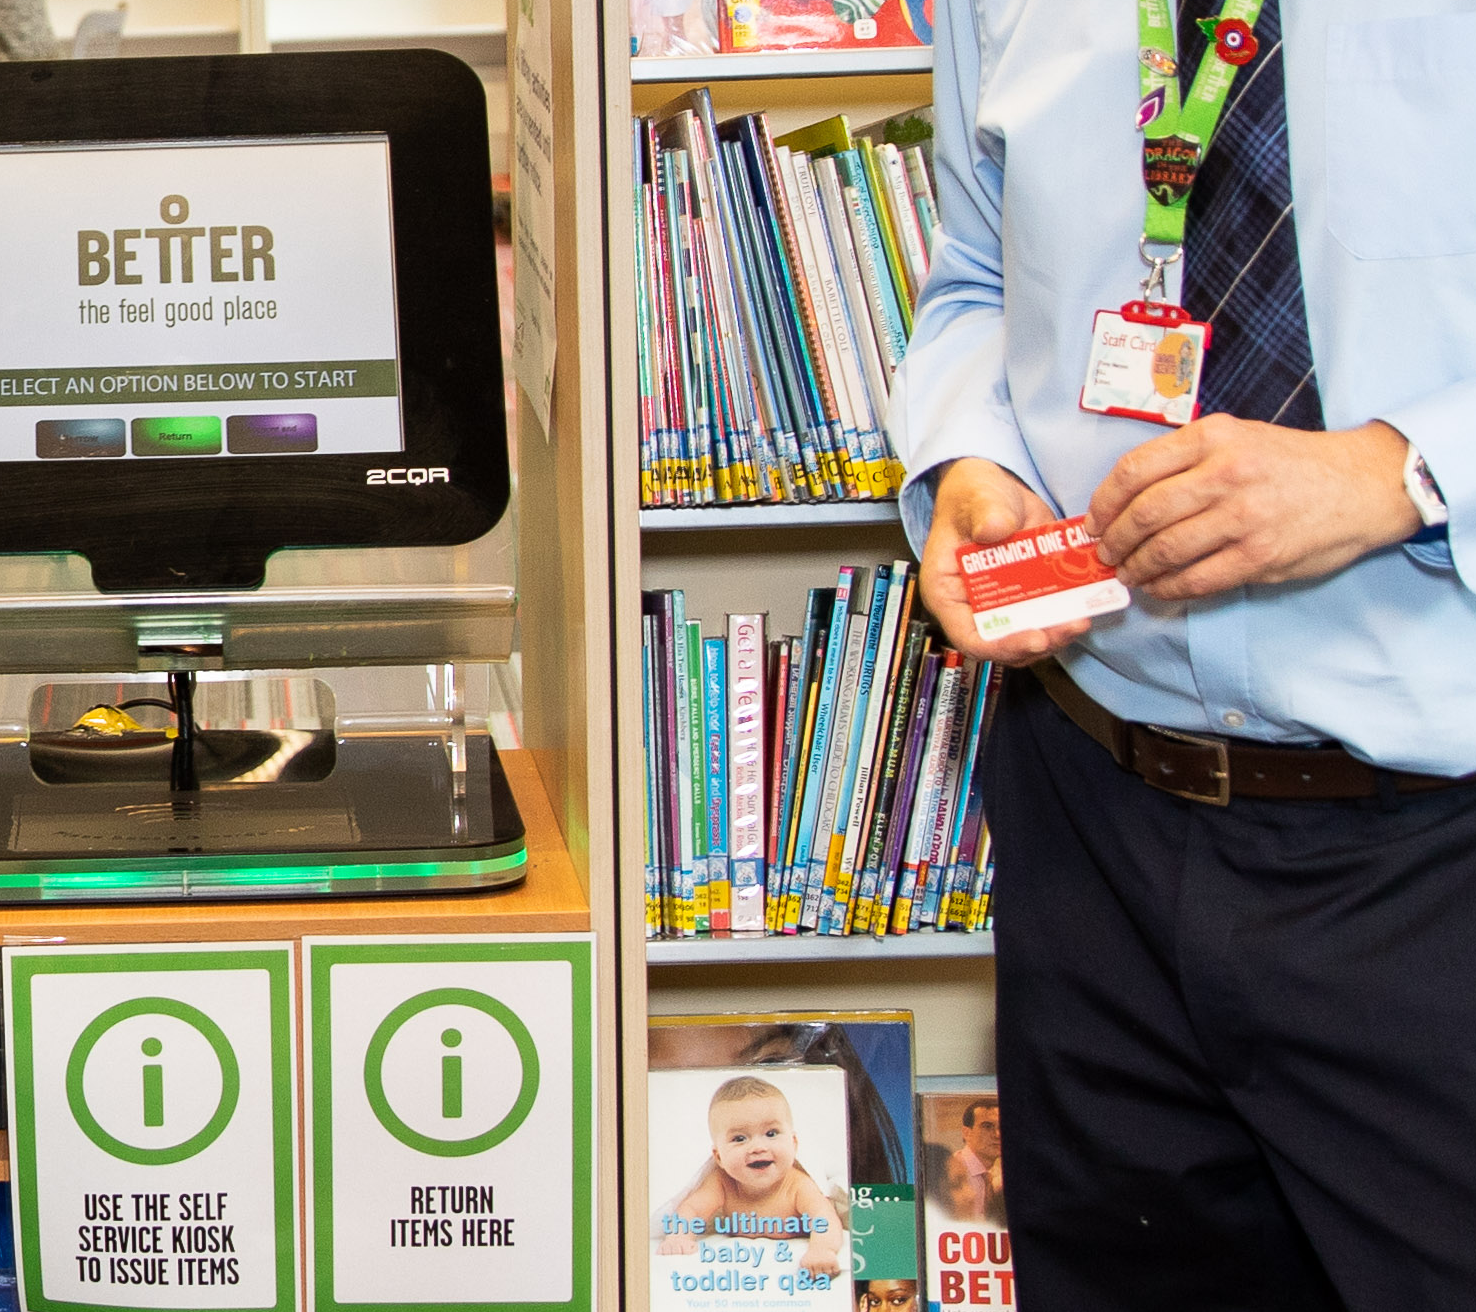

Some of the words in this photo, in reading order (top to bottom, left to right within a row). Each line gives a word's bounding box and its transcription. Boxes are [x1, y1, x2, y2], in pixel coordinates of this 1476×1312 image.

[77, 219, 276, 287] BETTER
[78, 299, 110, 325] the
[118, 298, 155, 323] feel
[165, 296, 214, 327] good
[223, 295, 278, 326] place
[1103, 331, 1127, 349] Staff
[1130, 334, 1157, 353] Card
[65, 377, 95, 395] AN
[100, 374, 178, 394] OPTION
[183, 373, 255, 392] BELOW
[261, 372, 289, 390] TO
[294, 370, 357, 389] START
[159, 432, 192, 442] Return
[366, 467, 450, 487] 2CQR
[856, 470, 867, 482] C
[872, 471, 883, 483] C
[961, 539, 1037, 574] GREENWICH
[1038, 531, 1066, 555] ONE
[1069, 524, 1094, 547] CA
[873, 602, 884, 623] Your
[860, 658, 876, 695] DRUGS
[892, 668, 914, 742] GUERRILLA
[815, 703, 830, 749] Wheelchair
[811, 749, 823, 775] User
[885, 743, 900, 778] MUM
[855, 766, 869, 798] Jillian
[852, 799, 864, 827] Powell
[84, 1194, 124, 1222] USE
[130, 1193, 172, 1222] THE
[178, 1192, 228, 1221] SELF
[410, 1186, 494, 1214] RETURN
[390, 1219, 453, 1248] ITEMS
[462, 1218, 515, 1247] HERE
[661, 1213, 706, 1235] the
[714, 1211, 829, 1235] ultimate
[78, 1226, 165, 1254] SERVICE
[171, 1225, 236, 1253] KIOSK
[699, 1240, 765, 1267] baby
[774, 1241, 792, 1263] &
[76, 1256, 101, 1282] TO
[109, 1256, 169, 1285] ISSUE
[177, 1257, 240, 1286] ITEMS
[671, 1270, 770, 1292] toddler
[778, 1271, 832, 1296] q&a
[686, 1299, 712, 1309] Your
[714, 1299, 729, 1308] 50
[732, 1299, 760, 1309] most
[762, 1300, 812, 1309] common
